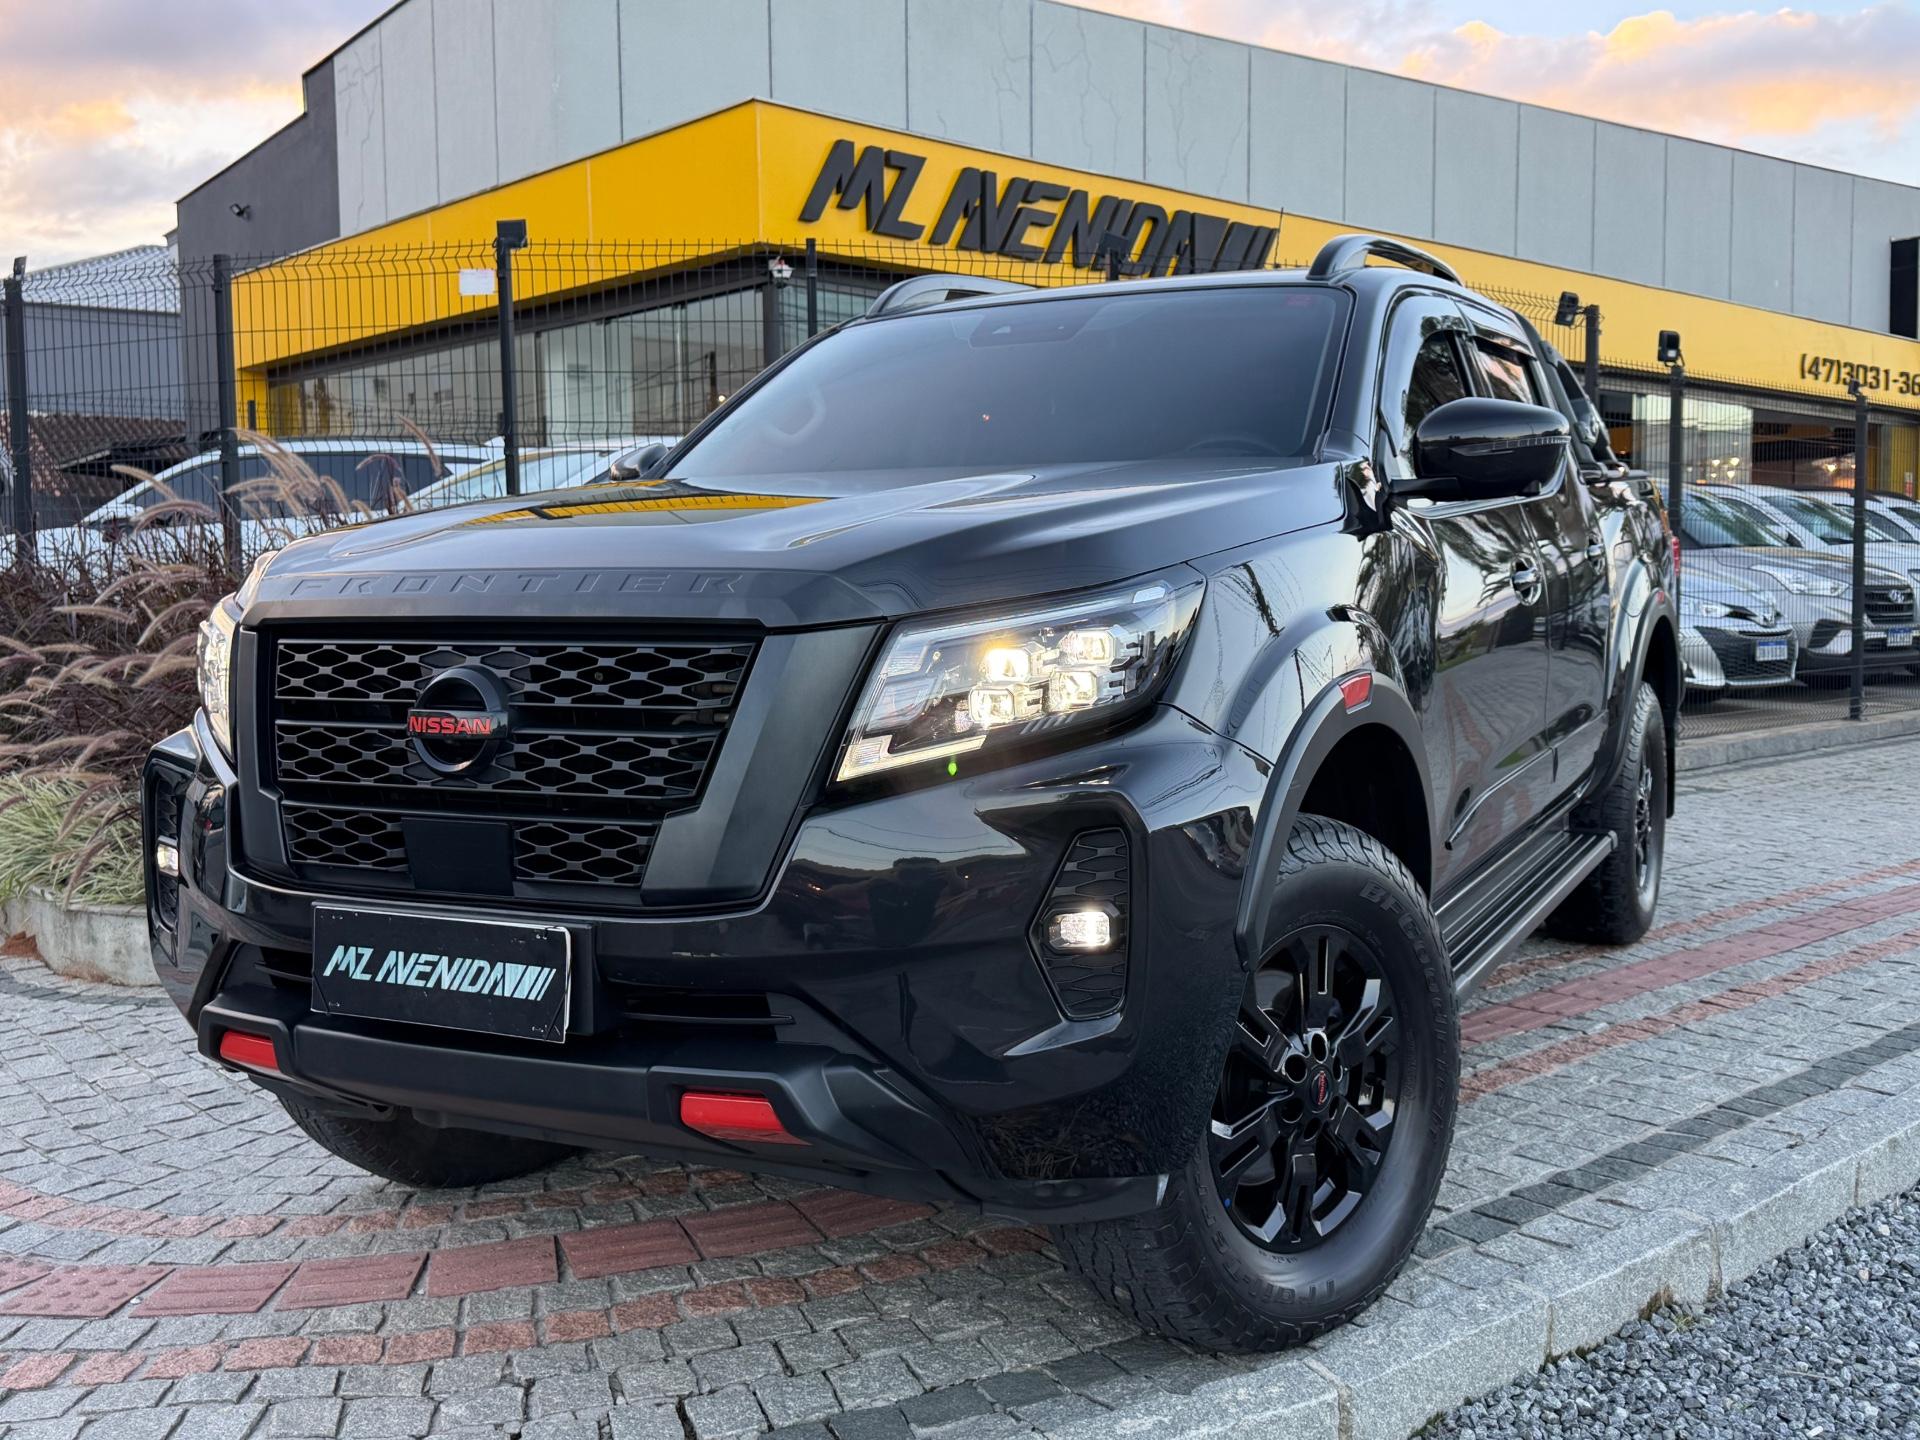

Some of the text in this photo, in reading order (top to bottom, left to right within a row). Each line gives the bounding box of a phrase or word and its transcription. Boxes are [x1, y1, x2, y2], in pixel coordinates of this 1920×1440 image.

[798, 139, 927, 241] MZ
[289, 572, 744, 596] FRONTIER
[408, 715, 492, 735] NISSAN
[322, 945, 505, 997] MZ AVENIDA
